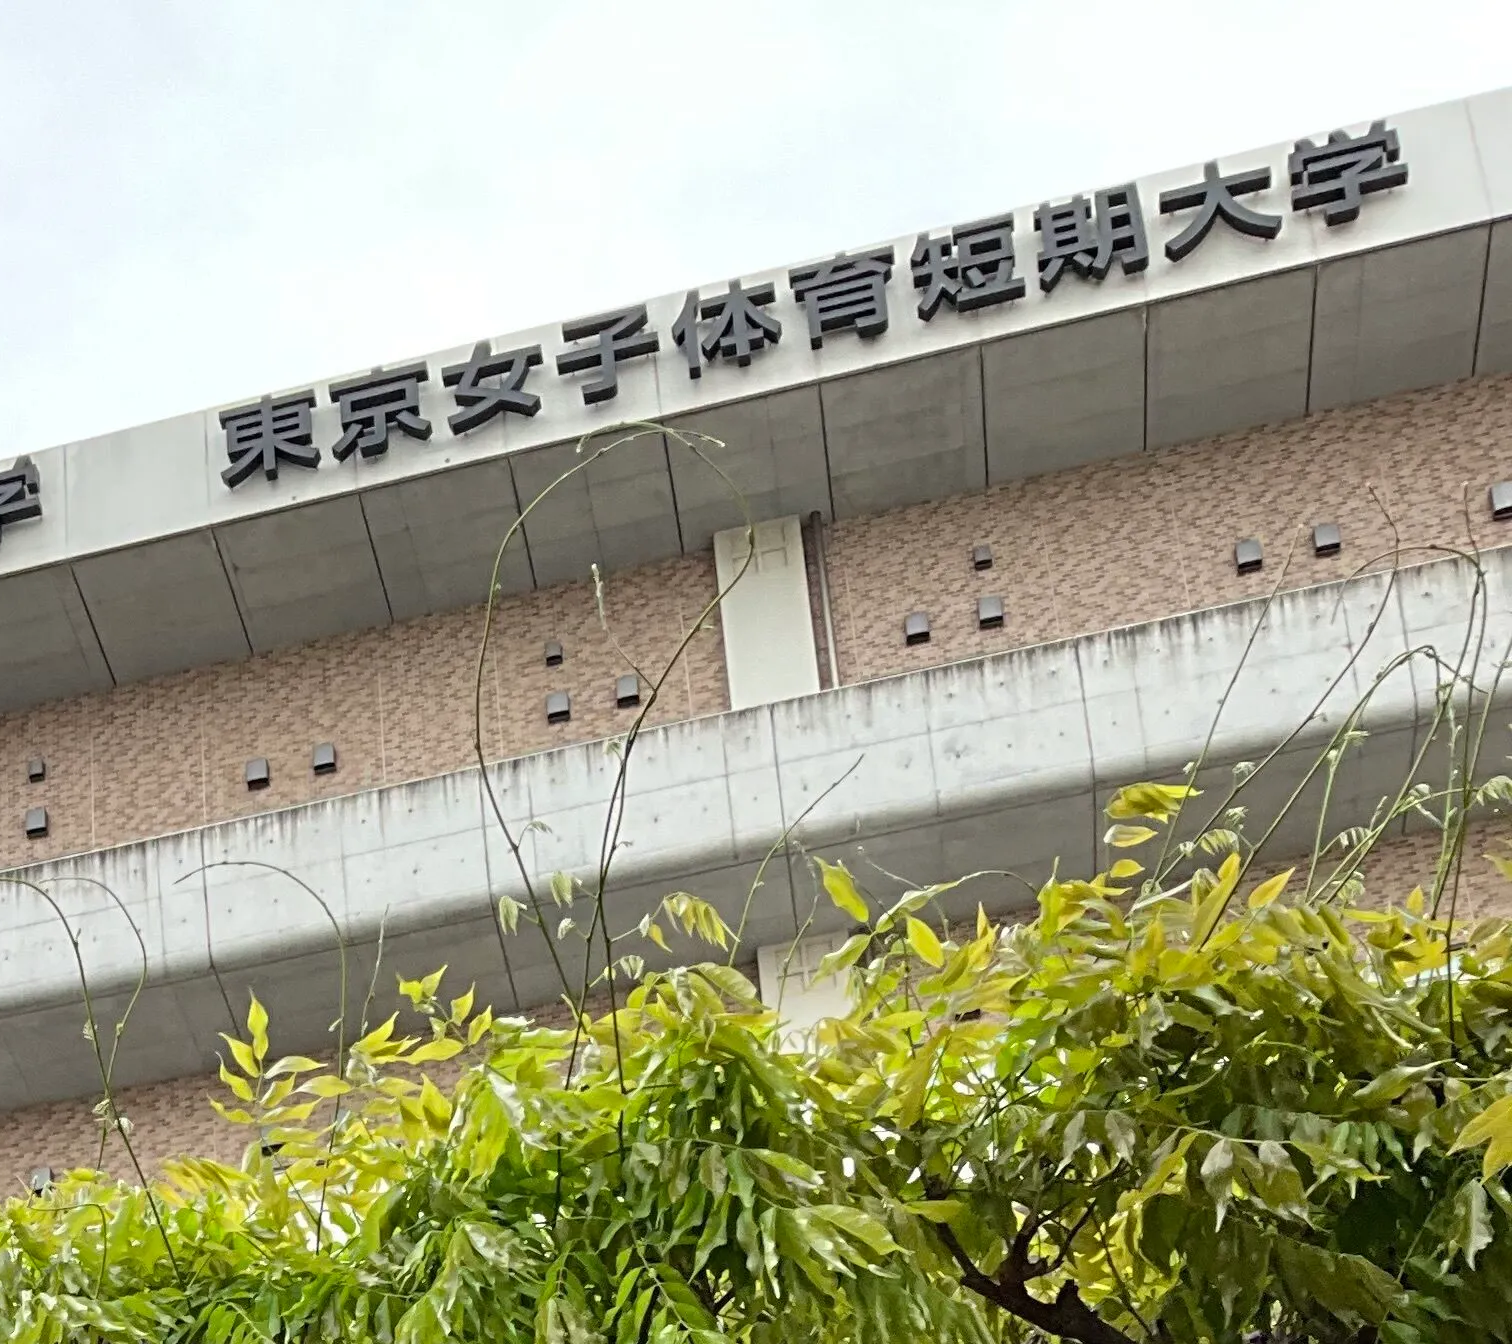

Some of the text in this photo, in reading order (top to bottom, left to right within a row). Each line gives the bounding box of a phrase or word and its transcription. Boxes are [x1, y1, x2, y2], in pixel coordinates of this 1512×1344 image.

[219, 120, 1409, 491] 東京女子体育短期大学
